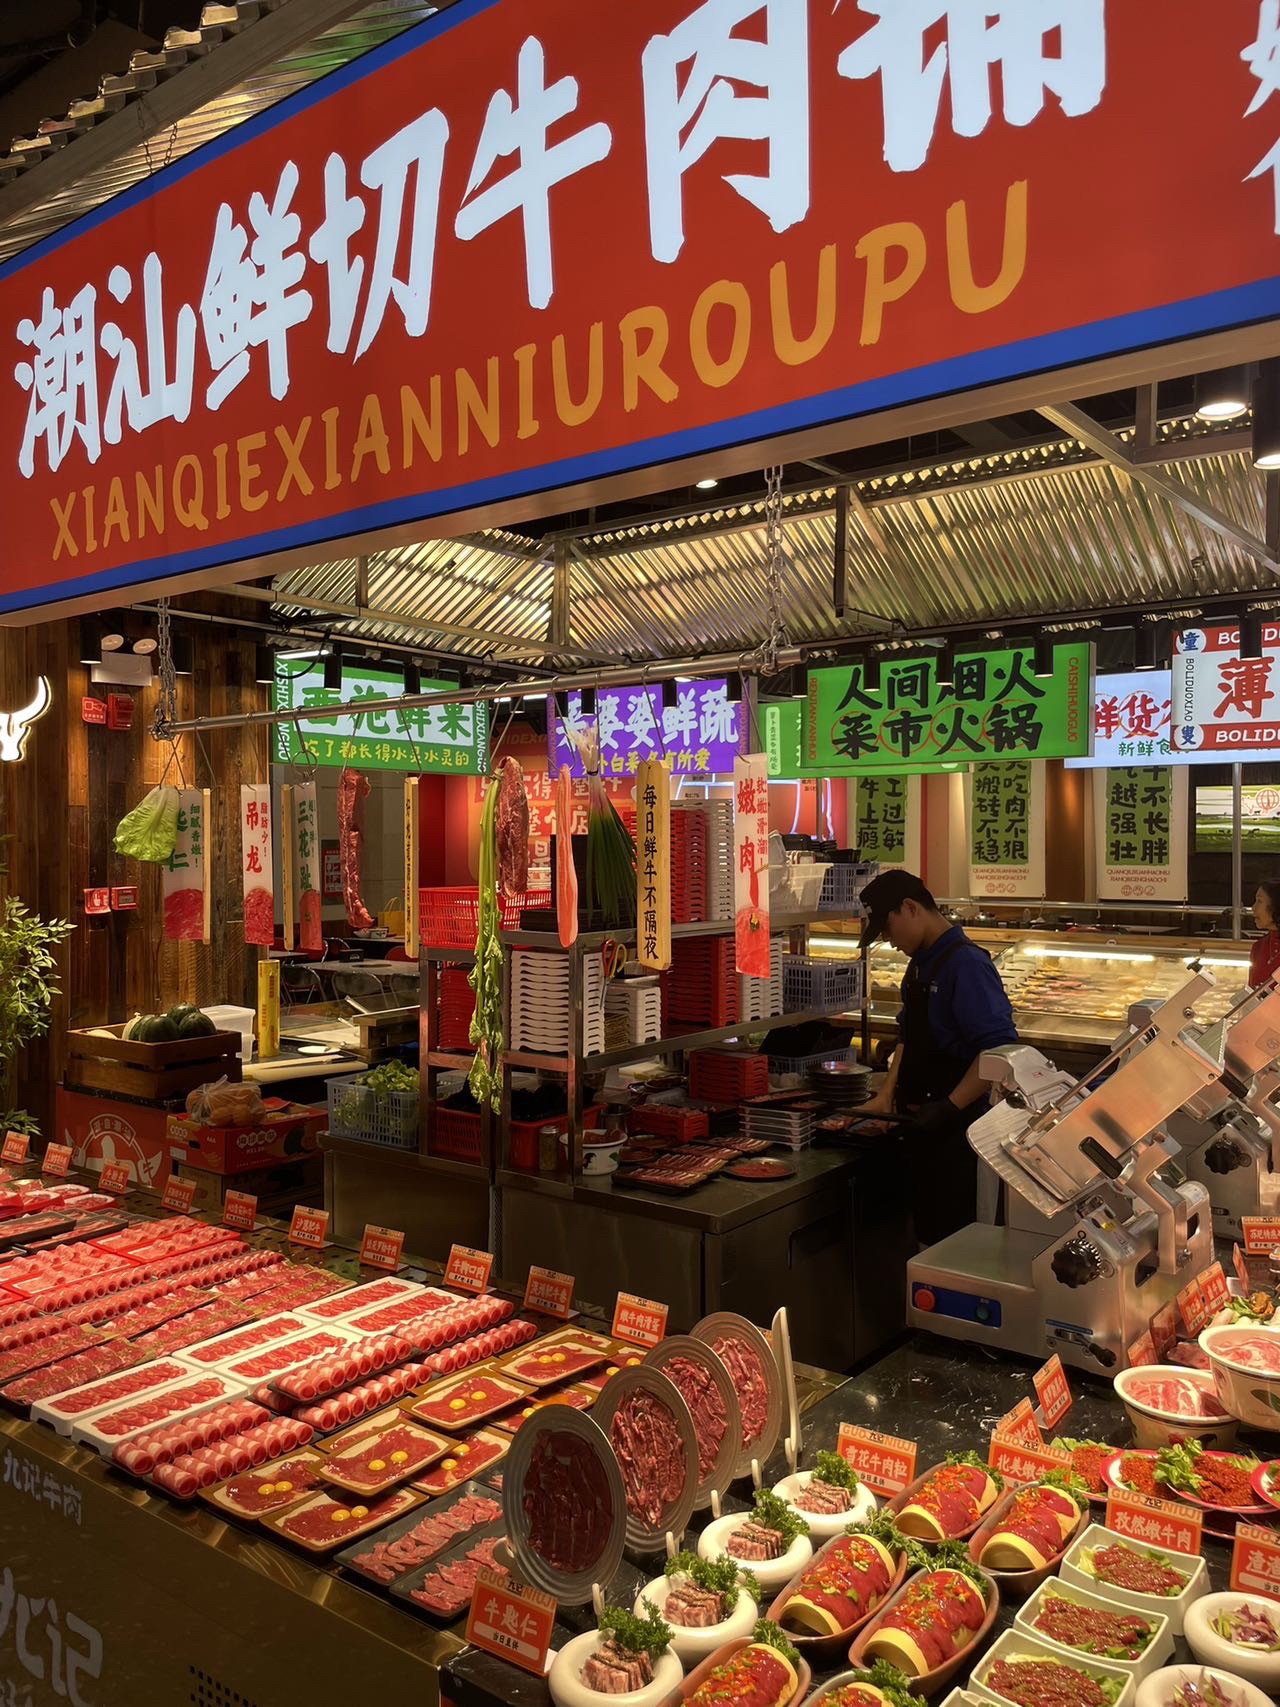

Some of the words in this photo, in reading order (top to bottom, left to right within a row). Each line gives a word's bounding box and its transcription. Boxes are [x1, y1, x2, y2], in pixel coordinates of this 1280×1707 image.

[51, 179, 1028, 560] XIANQIEXIANNIUROUPU
[835, 651, 1046, 712] 人间烟火
[1213, 656, 1276, 719] 薄
[832, 702, 1043, 760] 菜市火锅
[1216, 728, 1280, 743] BOLID
[642, 783, 660, 960] 每日鲜牛不隔夜
[1111, 1489, 1141, 1505] GUO
[1114, 1511, 1192, 1551] 孜然嫩牛肉
[480, 1570, 505, 1588] GUO
